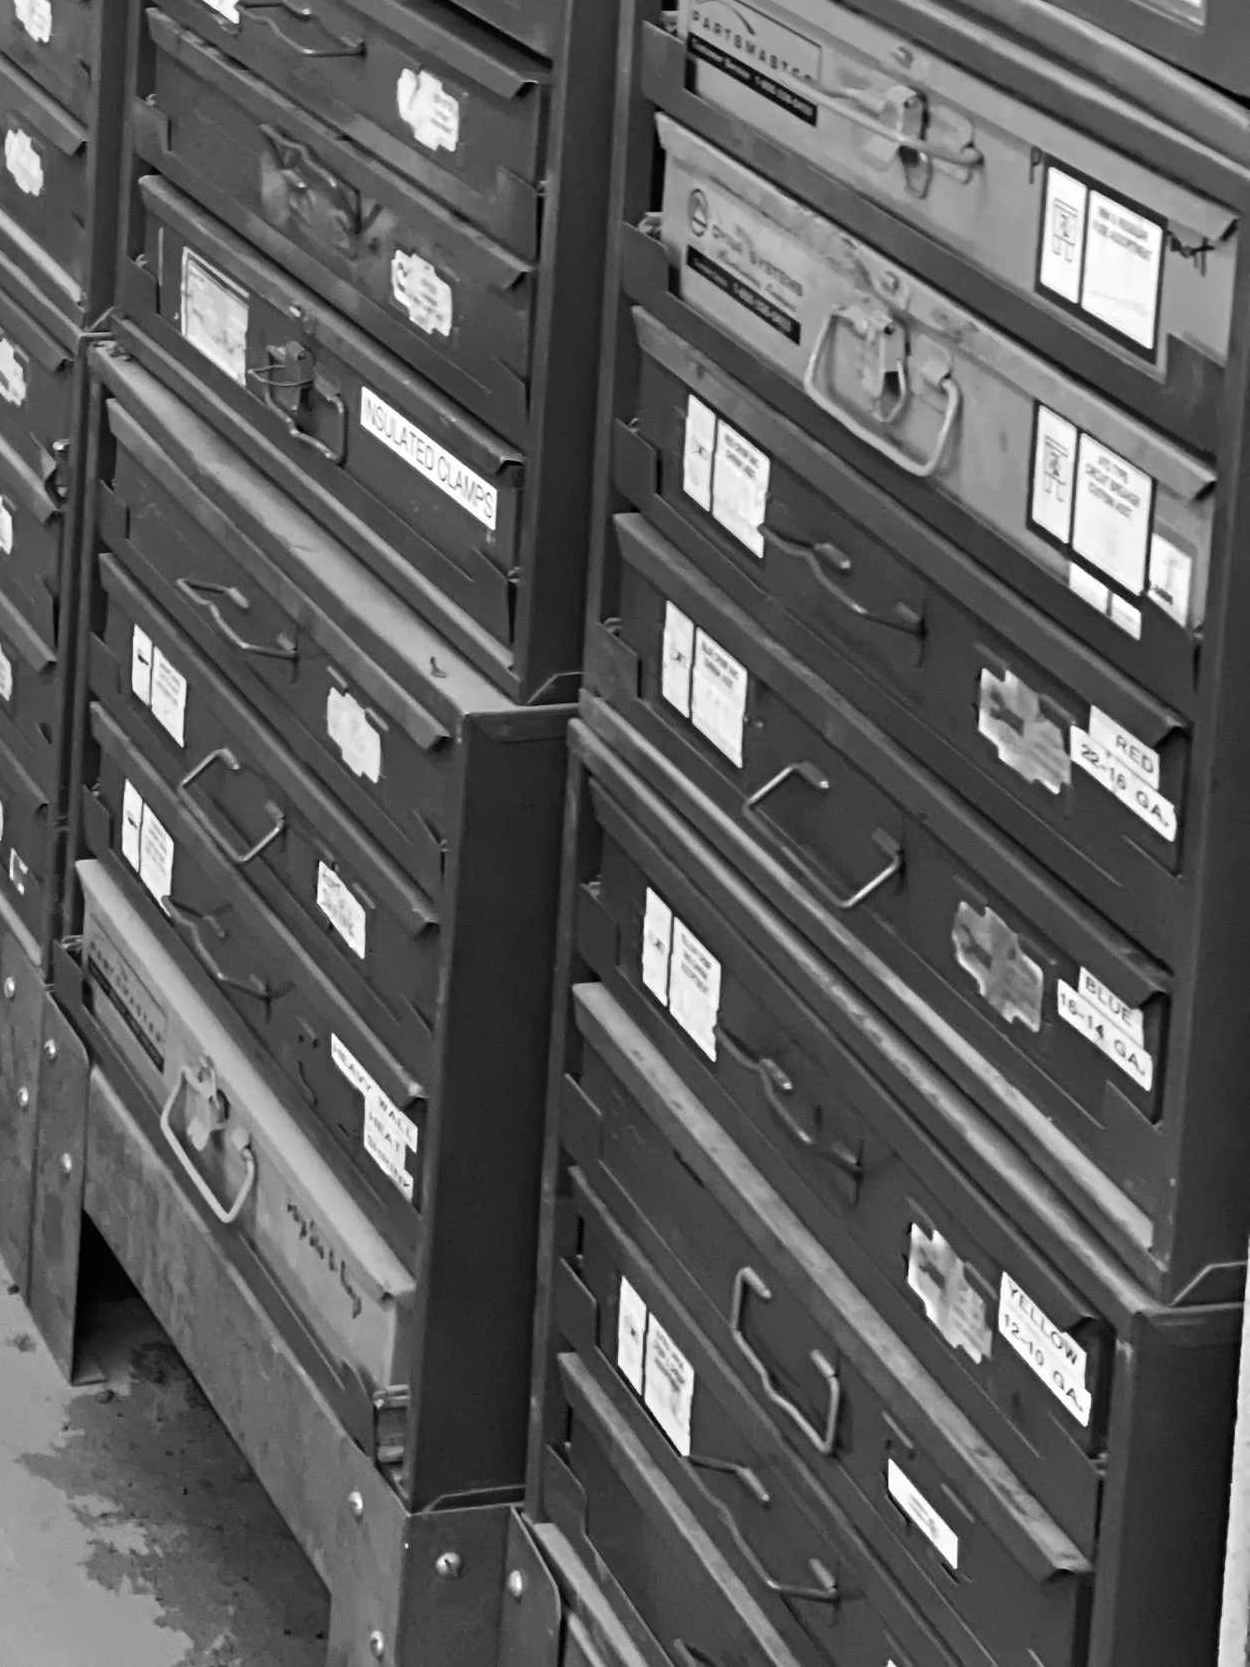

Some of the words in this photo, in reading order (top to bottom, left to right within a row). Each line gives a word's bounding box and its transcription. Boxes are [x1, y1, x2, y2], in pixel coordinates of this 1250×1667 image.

[437, 455, 494, 520] CLAMPS
[1080, 743, 1127, 791] 22-16
[1116, 734, 1155, 774] RED
[1061, 992, 1105, 1040] 16-14
[1085, 975, 1133, 1029] BLUE
[368, 1110, 401, 1154] HEAT
[1004, 1313, 1045, 1368] 12-10
[1008, 1276, 1079, 1366] YELLOW
